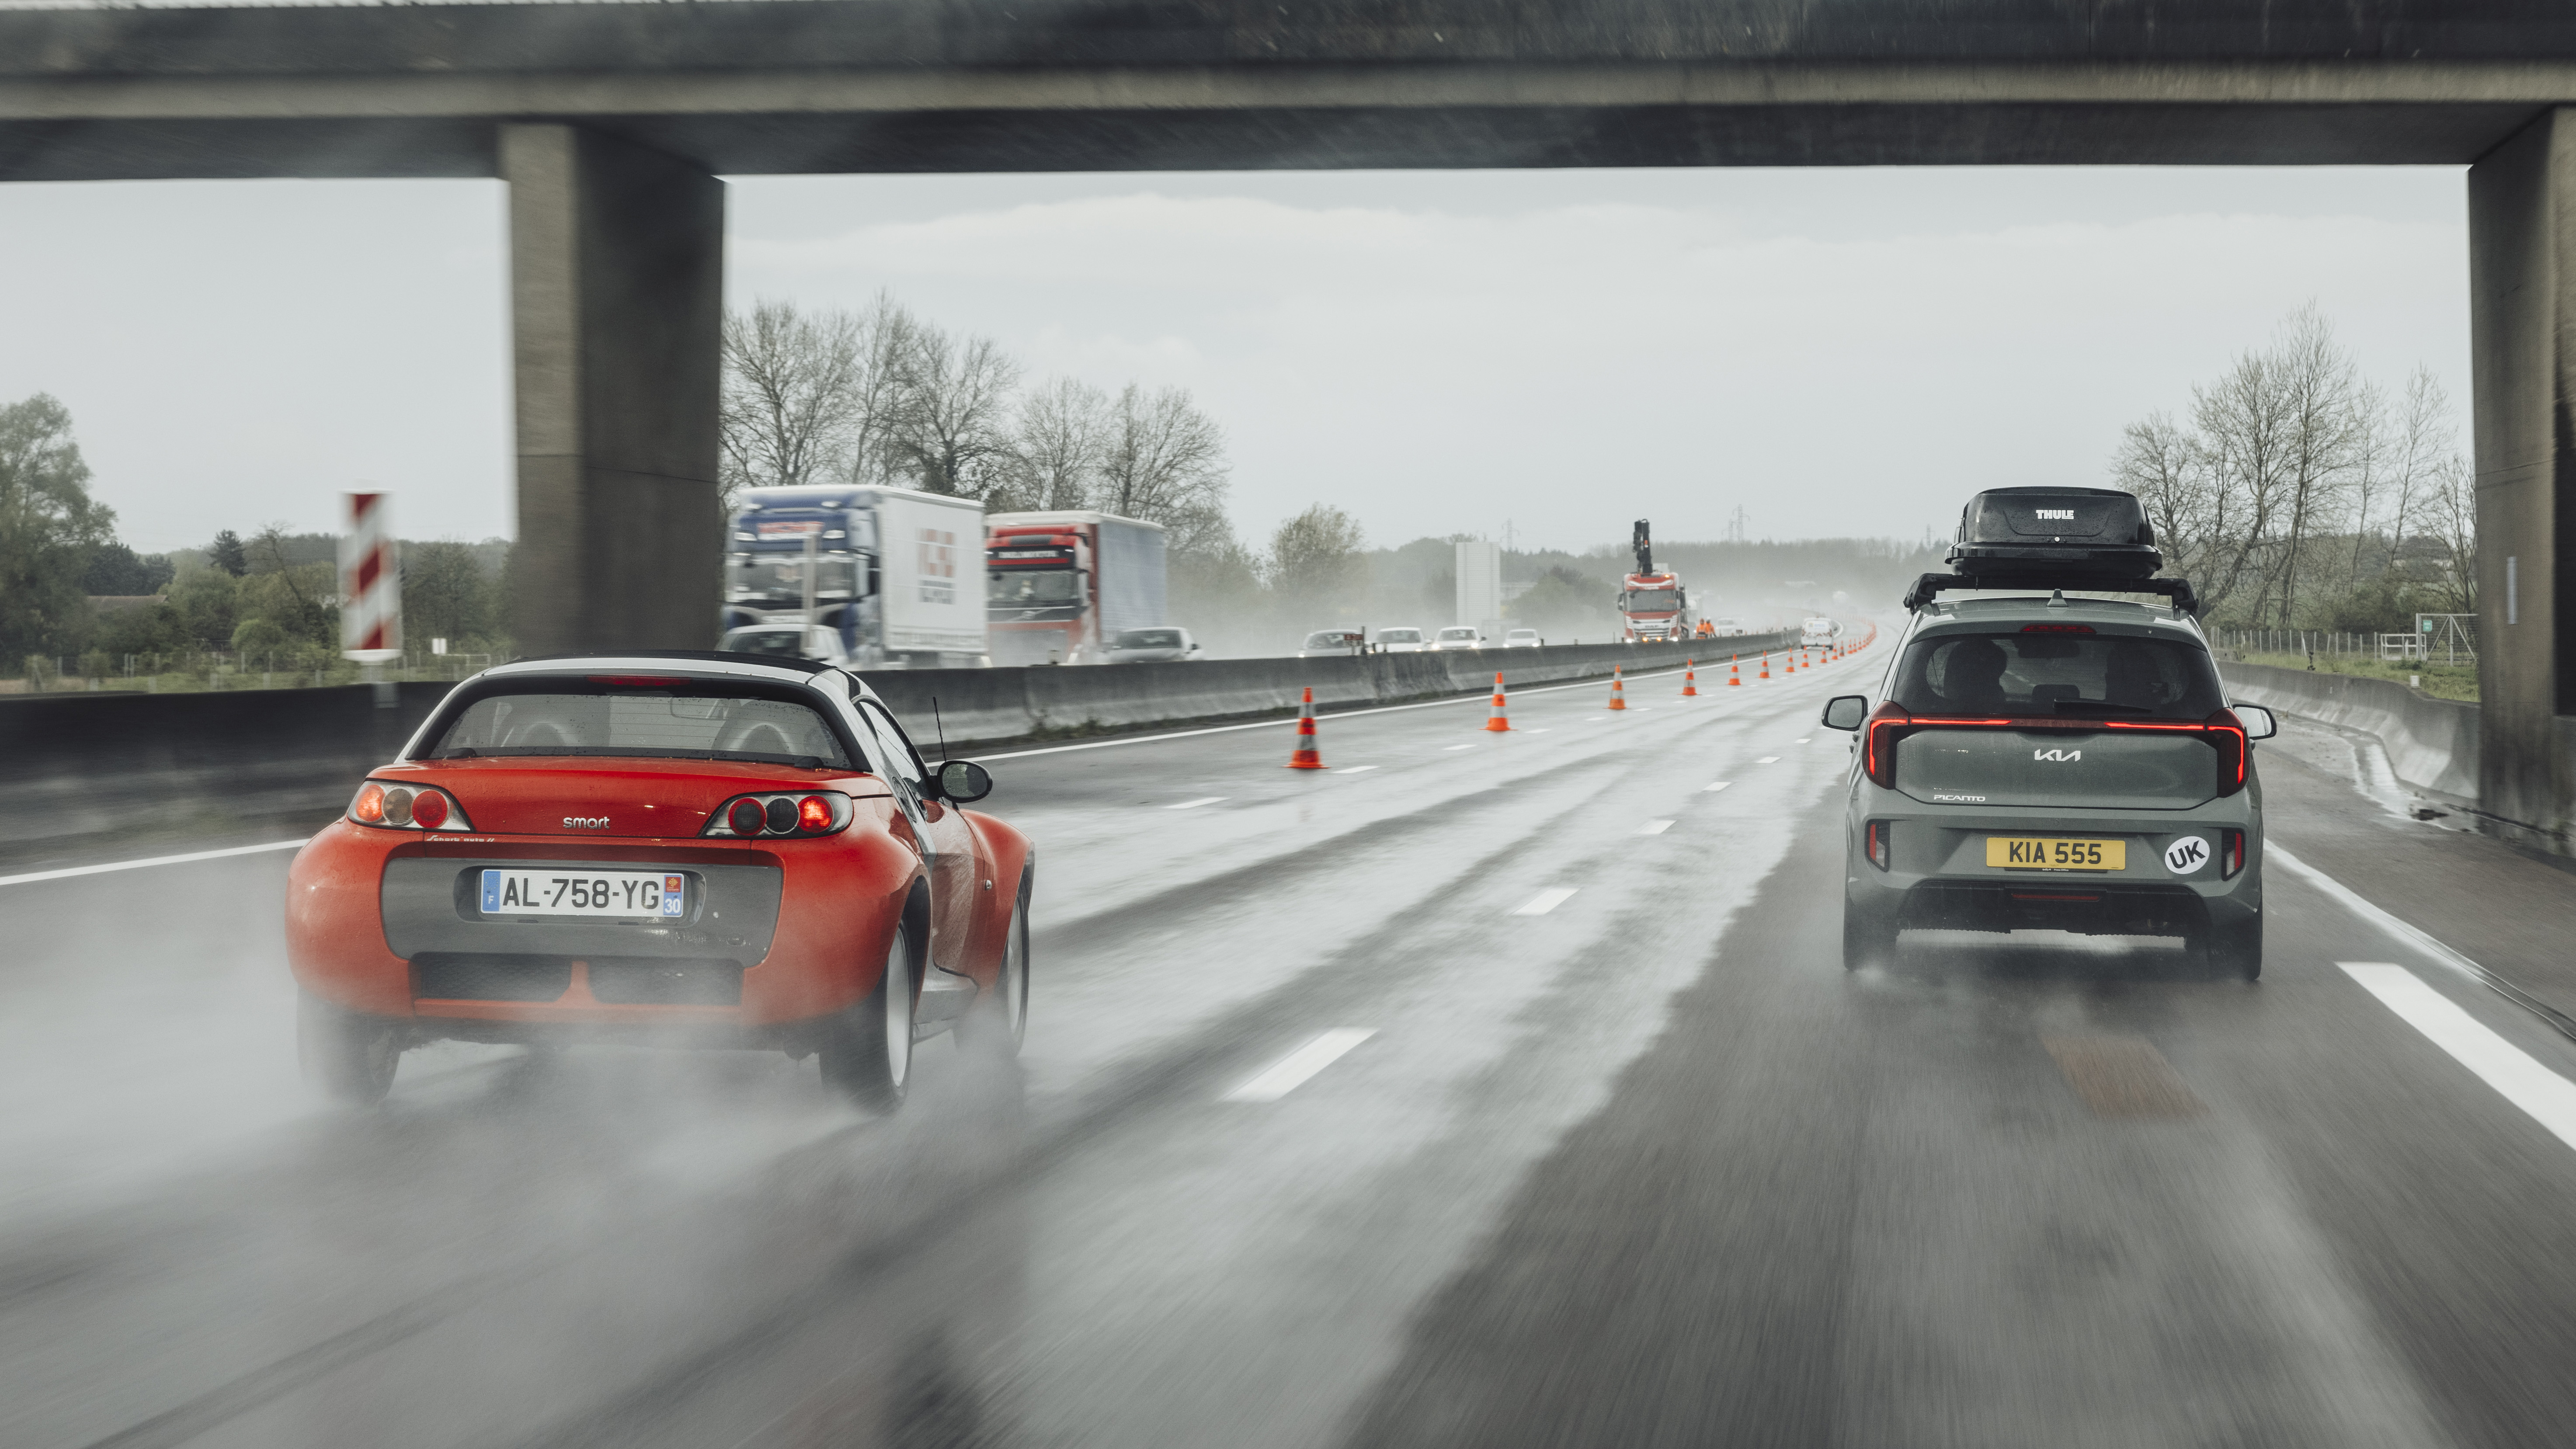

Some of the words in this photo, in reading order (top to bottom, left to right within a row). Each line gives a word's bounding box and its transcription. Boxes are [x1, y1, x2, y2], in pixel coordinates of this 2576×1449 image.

[2036, 509, 2074, 520] THULE
[563, 816, 610, 829] smart
[2009, 841, 2046, 863] KIA
[2055, 842, 2101, 864] 555
[2168, 840, 2206, 869] UK
[488, 895, 494, 904] F
[503, 877, 659, 910] AL-758-YG
[664, 898, 681, 913] 30
